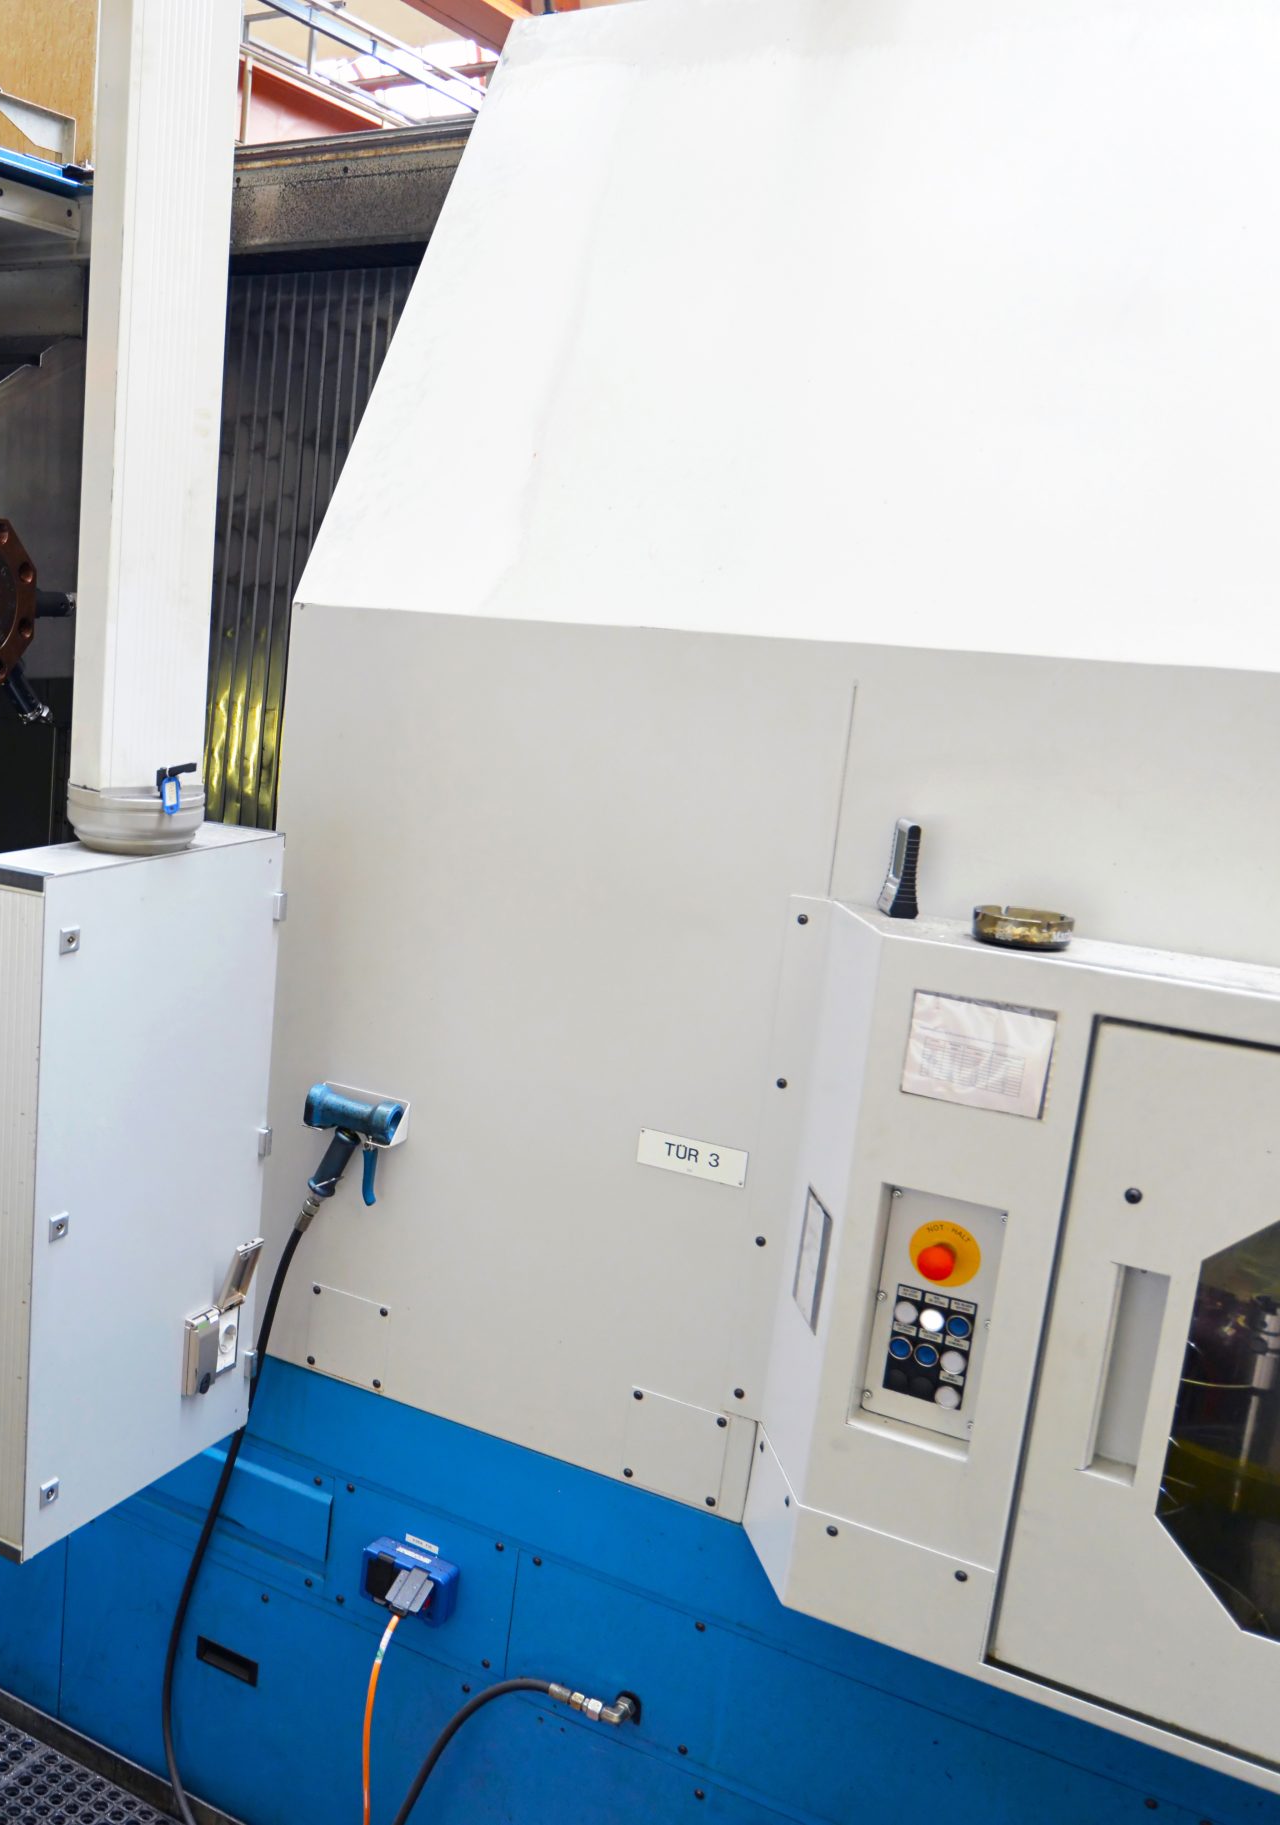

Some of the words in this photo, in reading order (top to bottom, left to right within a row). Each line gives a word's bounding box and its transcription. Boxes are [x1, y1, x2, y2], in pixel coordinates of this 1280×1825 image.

[664, 1141, 699, 1163] TÜR
[708, 1152, 721, 1168] 3
[926, 1224, 944, 1233] NOT
